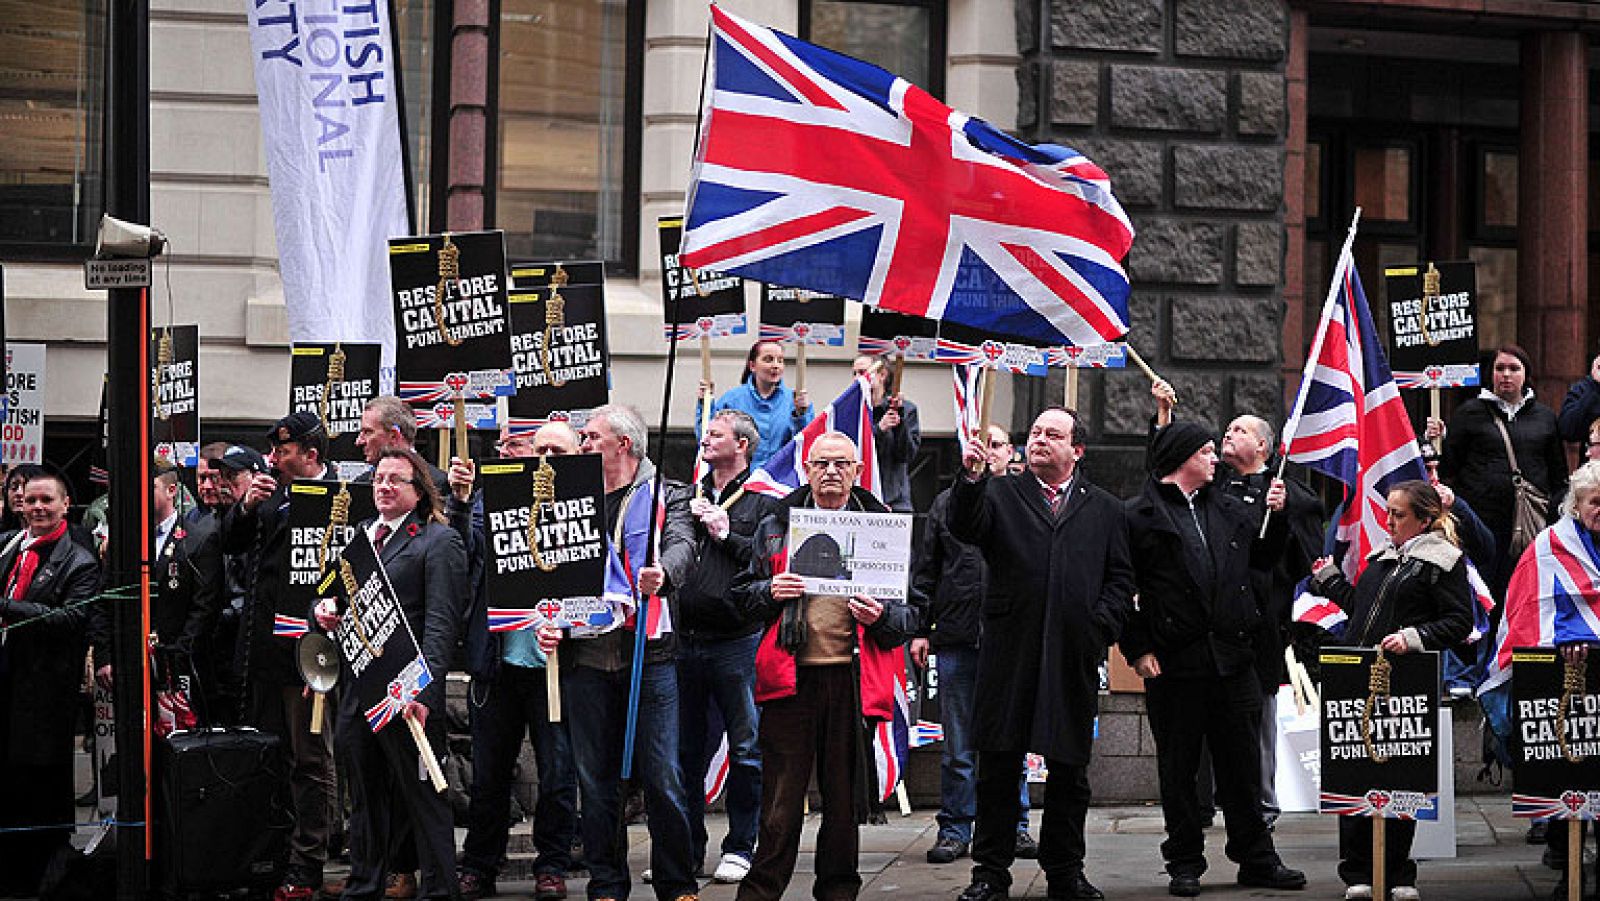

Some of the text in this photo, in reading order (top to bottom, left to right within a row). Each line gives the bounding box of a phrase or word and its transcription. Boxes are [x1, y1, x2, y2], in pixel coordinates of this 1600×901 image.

[256, 0, 302, 67] TY
[342, 0, 385, 106] TISH
[303, 0, 353, 173] IONAL
[91, 263, 147, 273] No loading
[90, 273, 147, 285] at any time
[8, 409, 40, 425] TISH
[791, 514, 801, 522] IS
[804, 515, 827, 525] THIS
[866, 518, 907, 528] WOMAN
[871, 540, 888, 549] OR
[818, 584, 840, 593] BAN
[843, 585, 864, 594] THE
